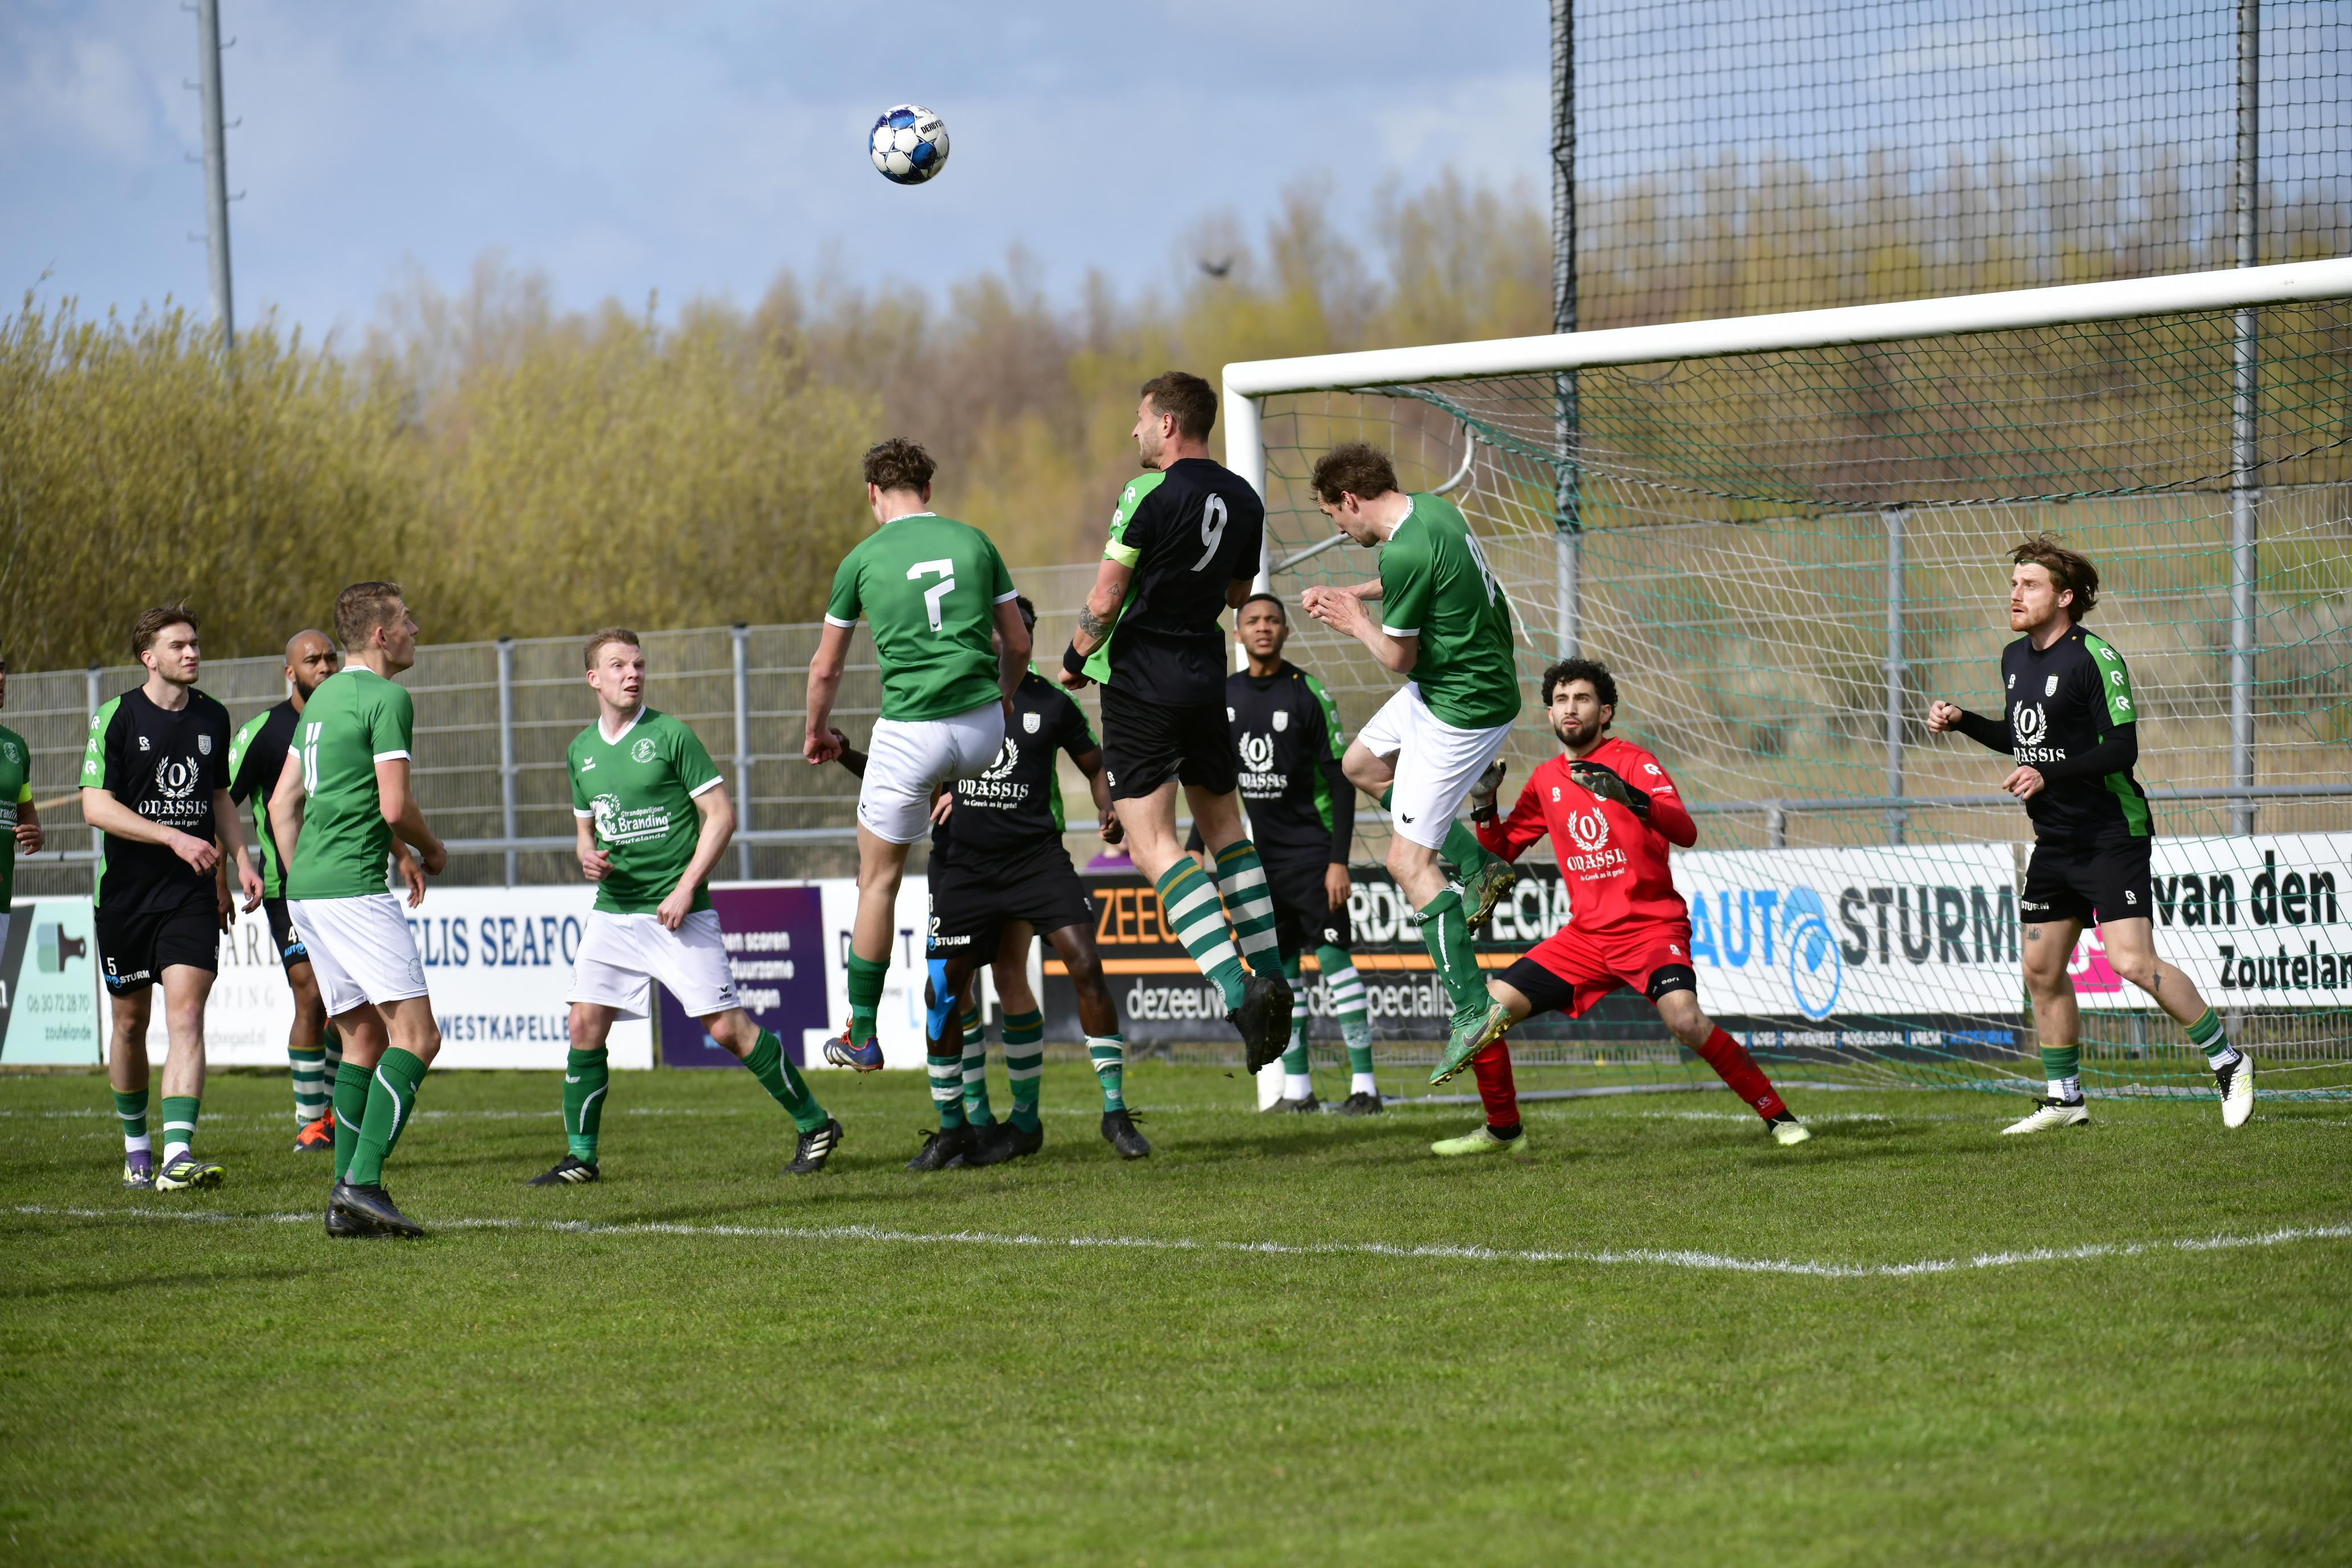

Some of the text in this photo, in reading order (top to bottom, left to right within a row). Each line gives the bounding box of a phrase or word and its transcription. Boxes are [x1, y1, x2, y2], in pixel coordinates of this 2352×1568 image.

[1190, 493, 1227, 571] 9
[906, 558, 955, 632] 7
[304, 721, 322, 798] 11
[2013, 747, 2066, 765] NASSIS
[620, 805, 664, 818] Strandpaviljoen
[615, 831, 667, 846] Zoutelande
[1586, 872, 1599, 881] Greek
[1612, 868, 1625, 878] gets!
[2152, 849, 2337, 927] van den
[1840, 885, 2018, 966] STURM
[481, 916, 581, 967] SEAFO
[745, 931, 790, 952] scoren
[935, 935, 970, 946] STURM
[107, 957, 117, 975] 5
[120, 970, 150, 983] STURM
[27, 995, 39, 1013] 06
[42, 995, 52, 1012] 30
[55, 995, 64, 1012] 72
[79, 994, 89, 1012] 70
[44, 1023, 91, 1041] zoutelande
